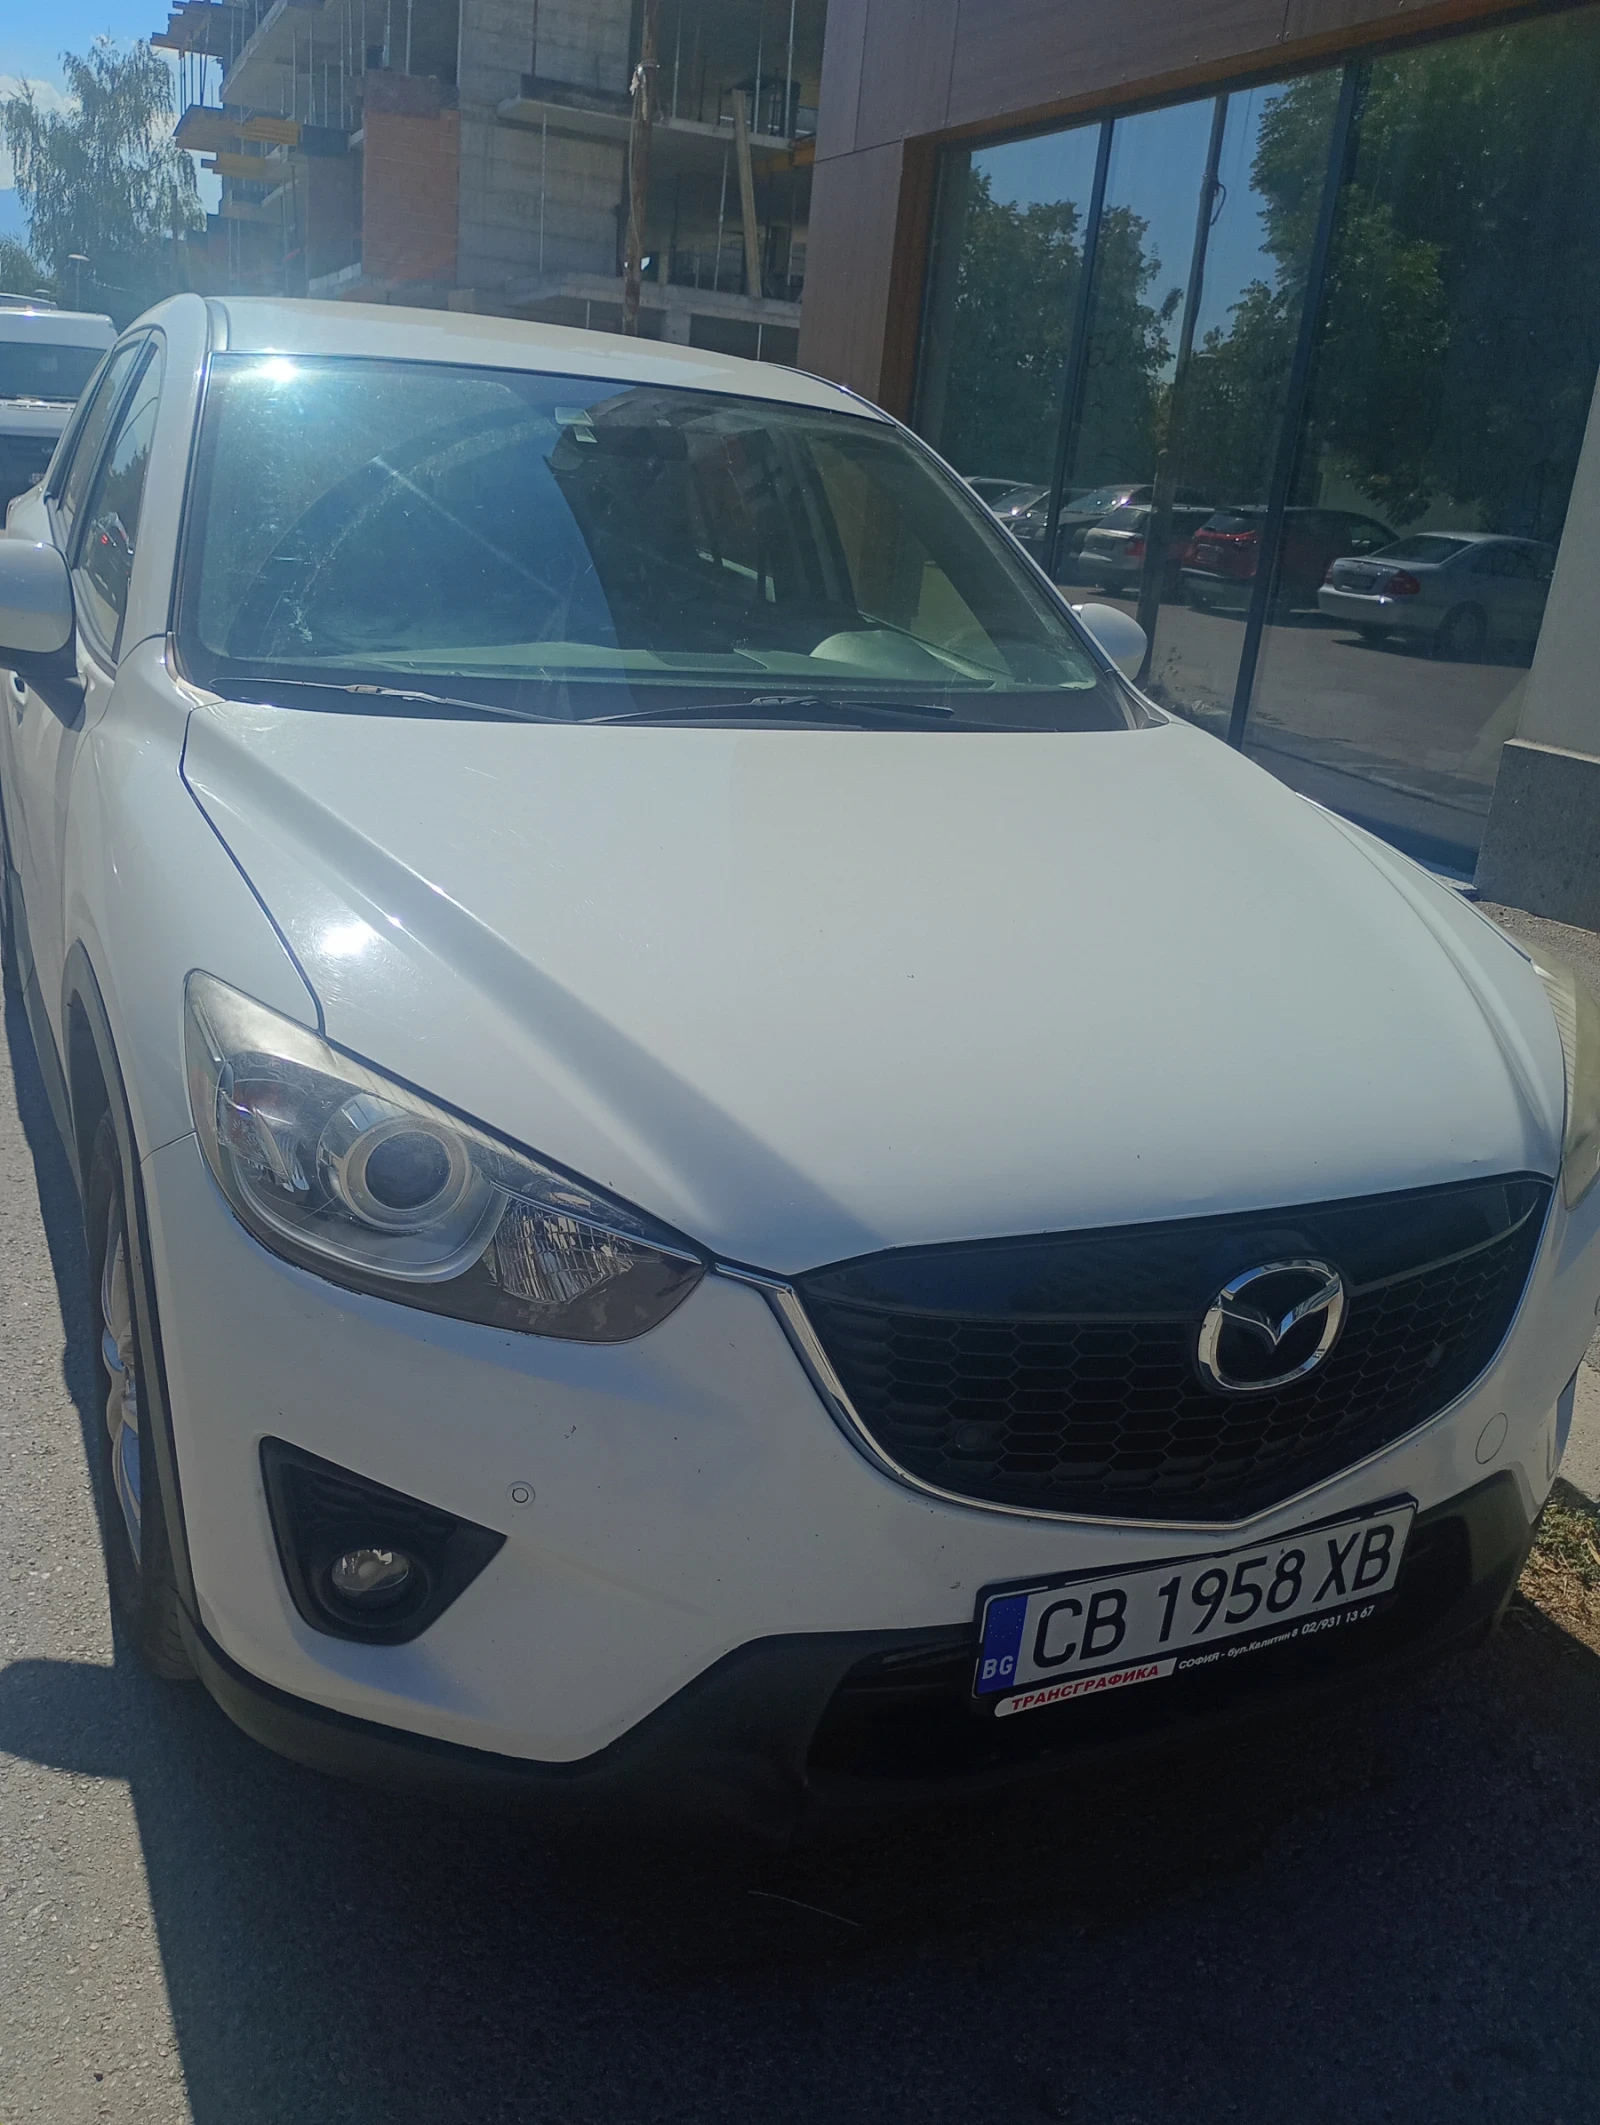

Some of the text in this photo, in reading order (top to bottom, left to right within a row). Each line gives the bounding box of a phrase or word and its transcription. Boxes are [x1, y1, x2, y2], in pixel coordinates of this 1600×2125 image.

[1156, 1548, 1306, 1643] 1958
[1179, 1652, 1220, 1669] СОФИЯ
[1301, 1615, 1341, 1635] 02/931
[1345, 1610, 1358, 1623] 13
[1360, 1604, 1375, 1619] 67
[982, 1655, 1014, 1680] BG
[1012, 1665, 1159, 1711] ТРАНСГРАФИКА
